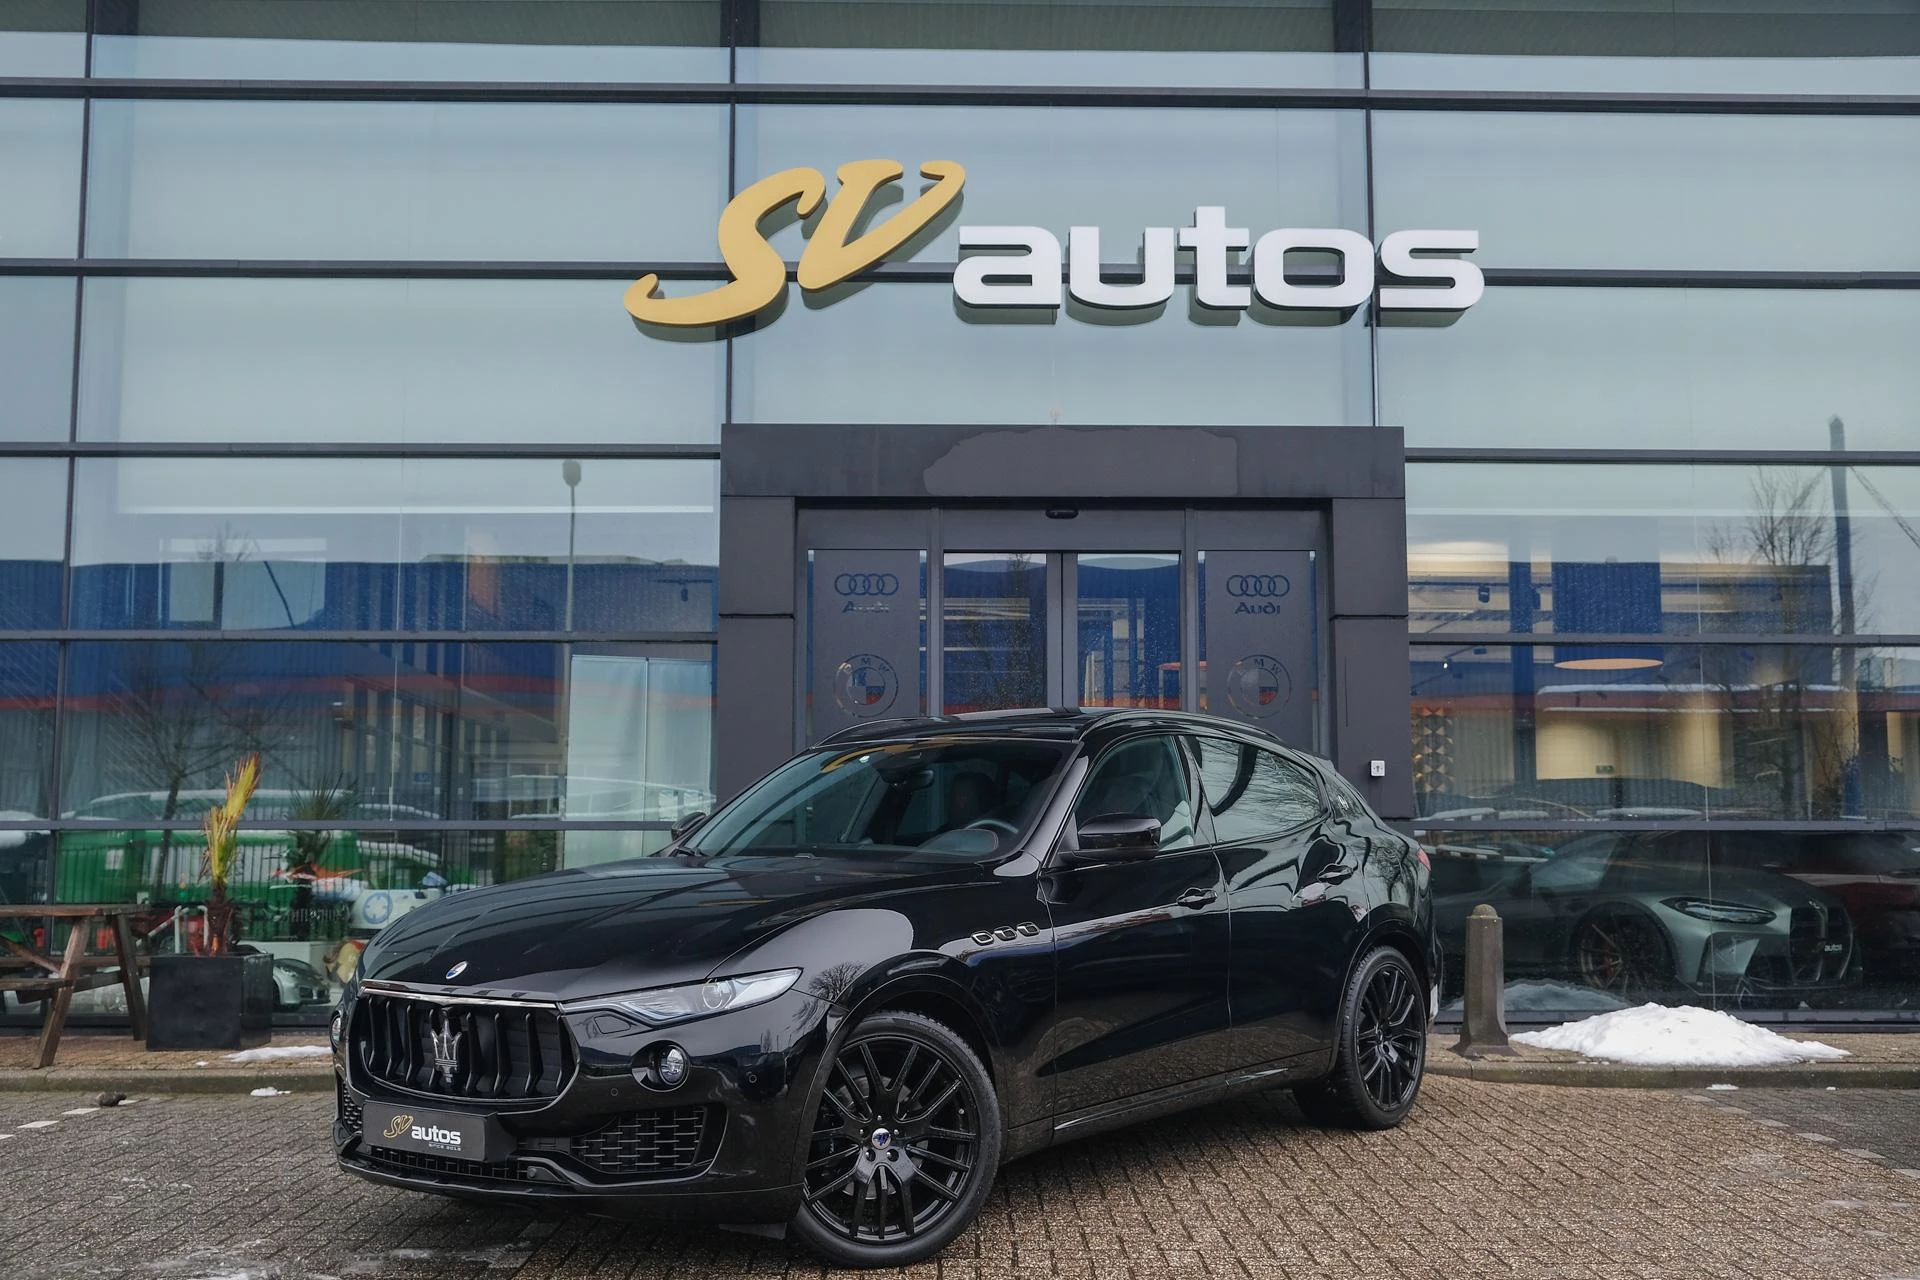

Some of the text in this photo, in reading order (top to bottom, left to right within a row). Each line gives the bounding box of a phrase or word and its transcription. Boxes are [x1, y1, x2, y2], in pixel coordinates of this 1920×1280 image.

[623, 159, 1486, 327] SV autos
[1234, 601, 1281, 615] Audi
[383, 1114, 462, 1145] SV autos
